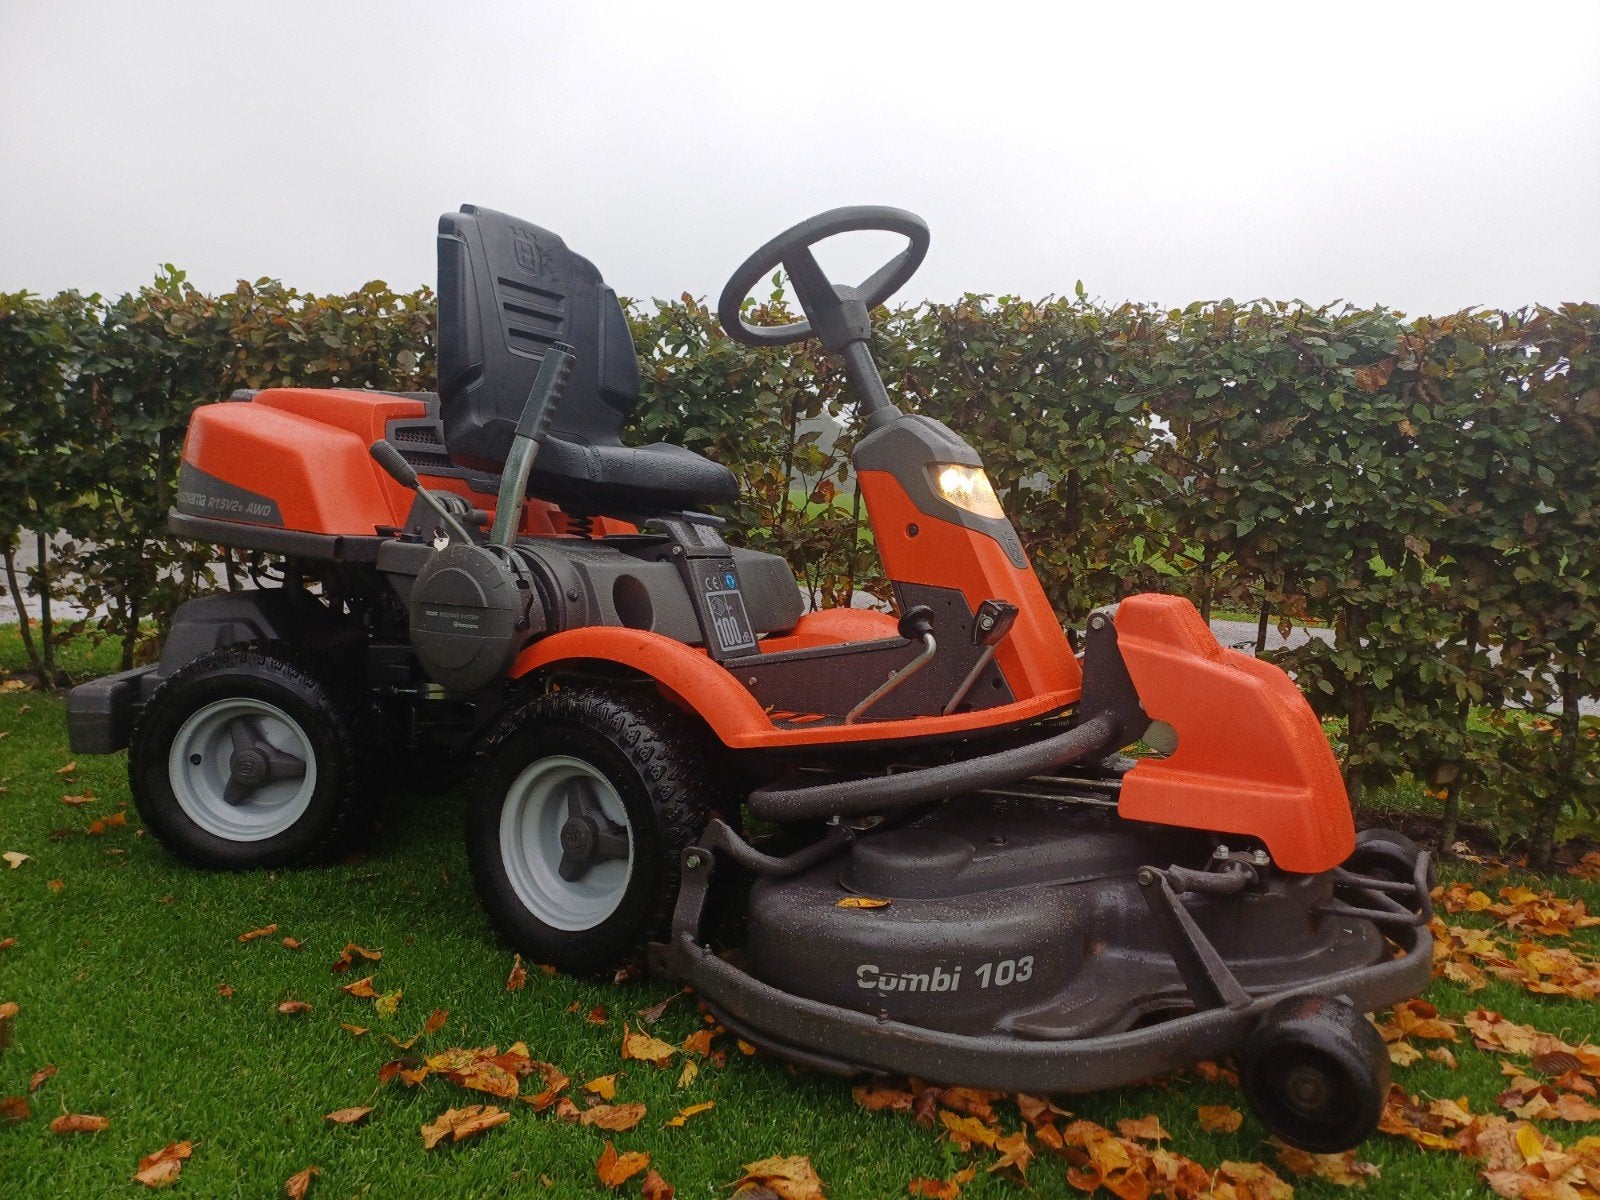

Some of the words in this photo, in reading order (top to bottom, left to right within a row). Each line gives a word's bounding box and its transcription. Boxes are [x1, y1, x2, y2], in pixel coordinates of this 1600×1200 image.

[245, 502, 272, 517] AWD
[717, 616, 743, 646] 100
[856, 964, 962, 992] Combi
[974, 955, 1035, 989] 103
